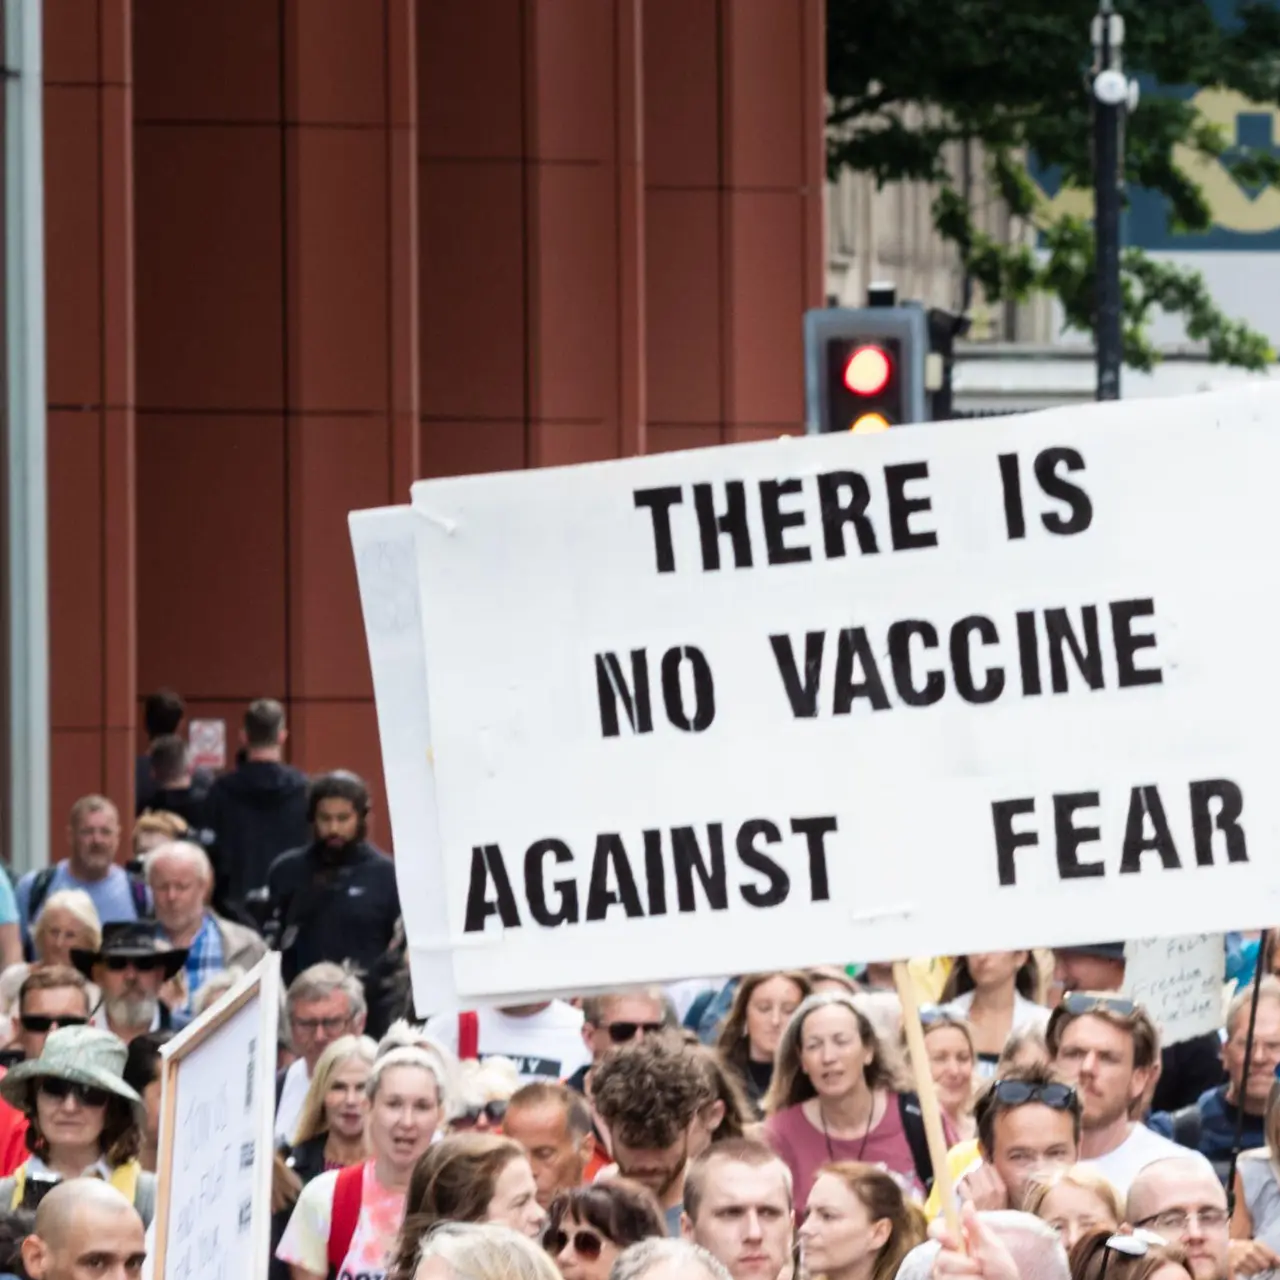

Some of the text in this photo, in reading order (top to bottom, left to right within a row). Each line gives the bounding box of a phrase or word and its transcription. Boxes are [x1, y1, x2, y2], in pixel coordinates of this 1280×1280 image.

[634, 448, 1092, 573] THERE IS
[596, 599, 1162, 738] NO VACCINE
[464, 779, 1249, 932] AGAINST FEAR
